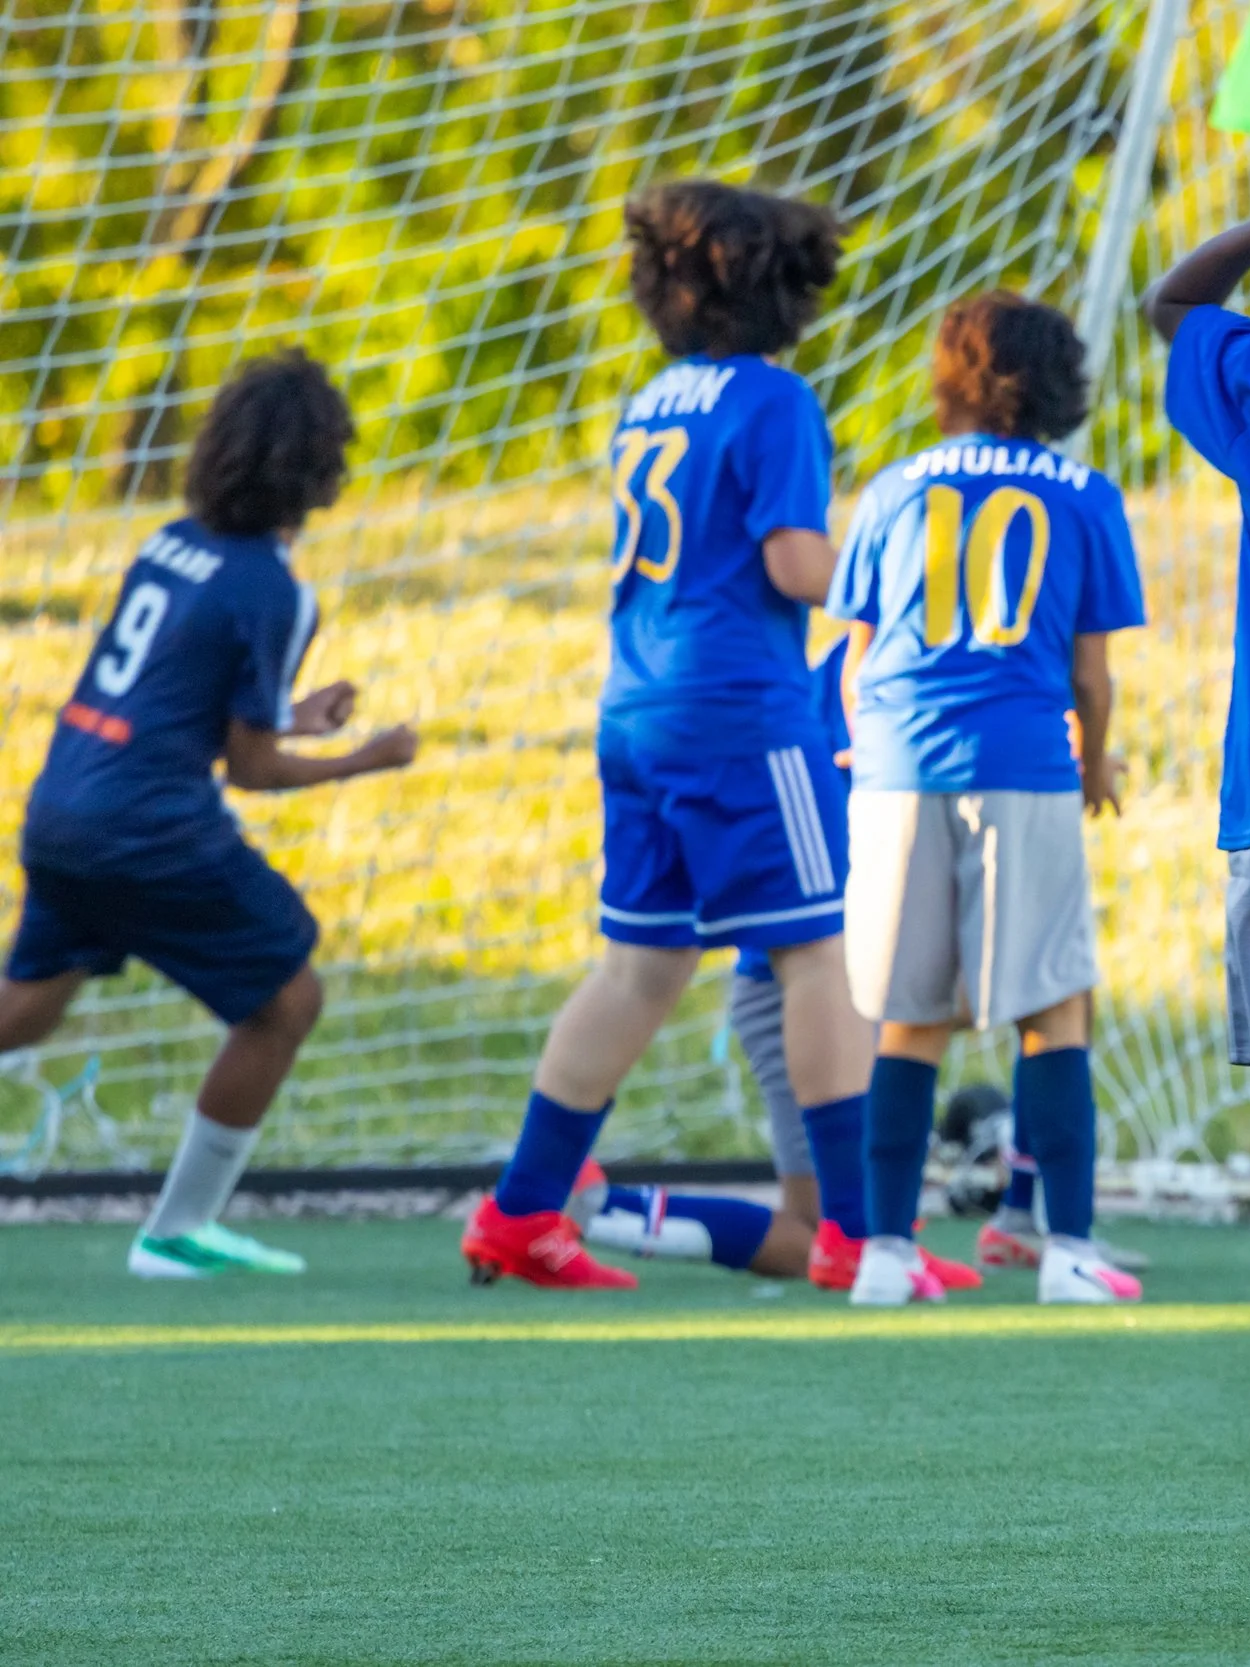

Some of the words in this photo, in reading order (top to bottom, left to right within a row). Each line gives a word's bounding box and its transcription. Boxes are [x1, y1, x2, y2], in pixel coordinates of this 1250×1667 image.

[902, 445, 1091, 492] JHULIAN
[923, 484, 1050, 648] 10
[95, 581, 170, 697] 9
